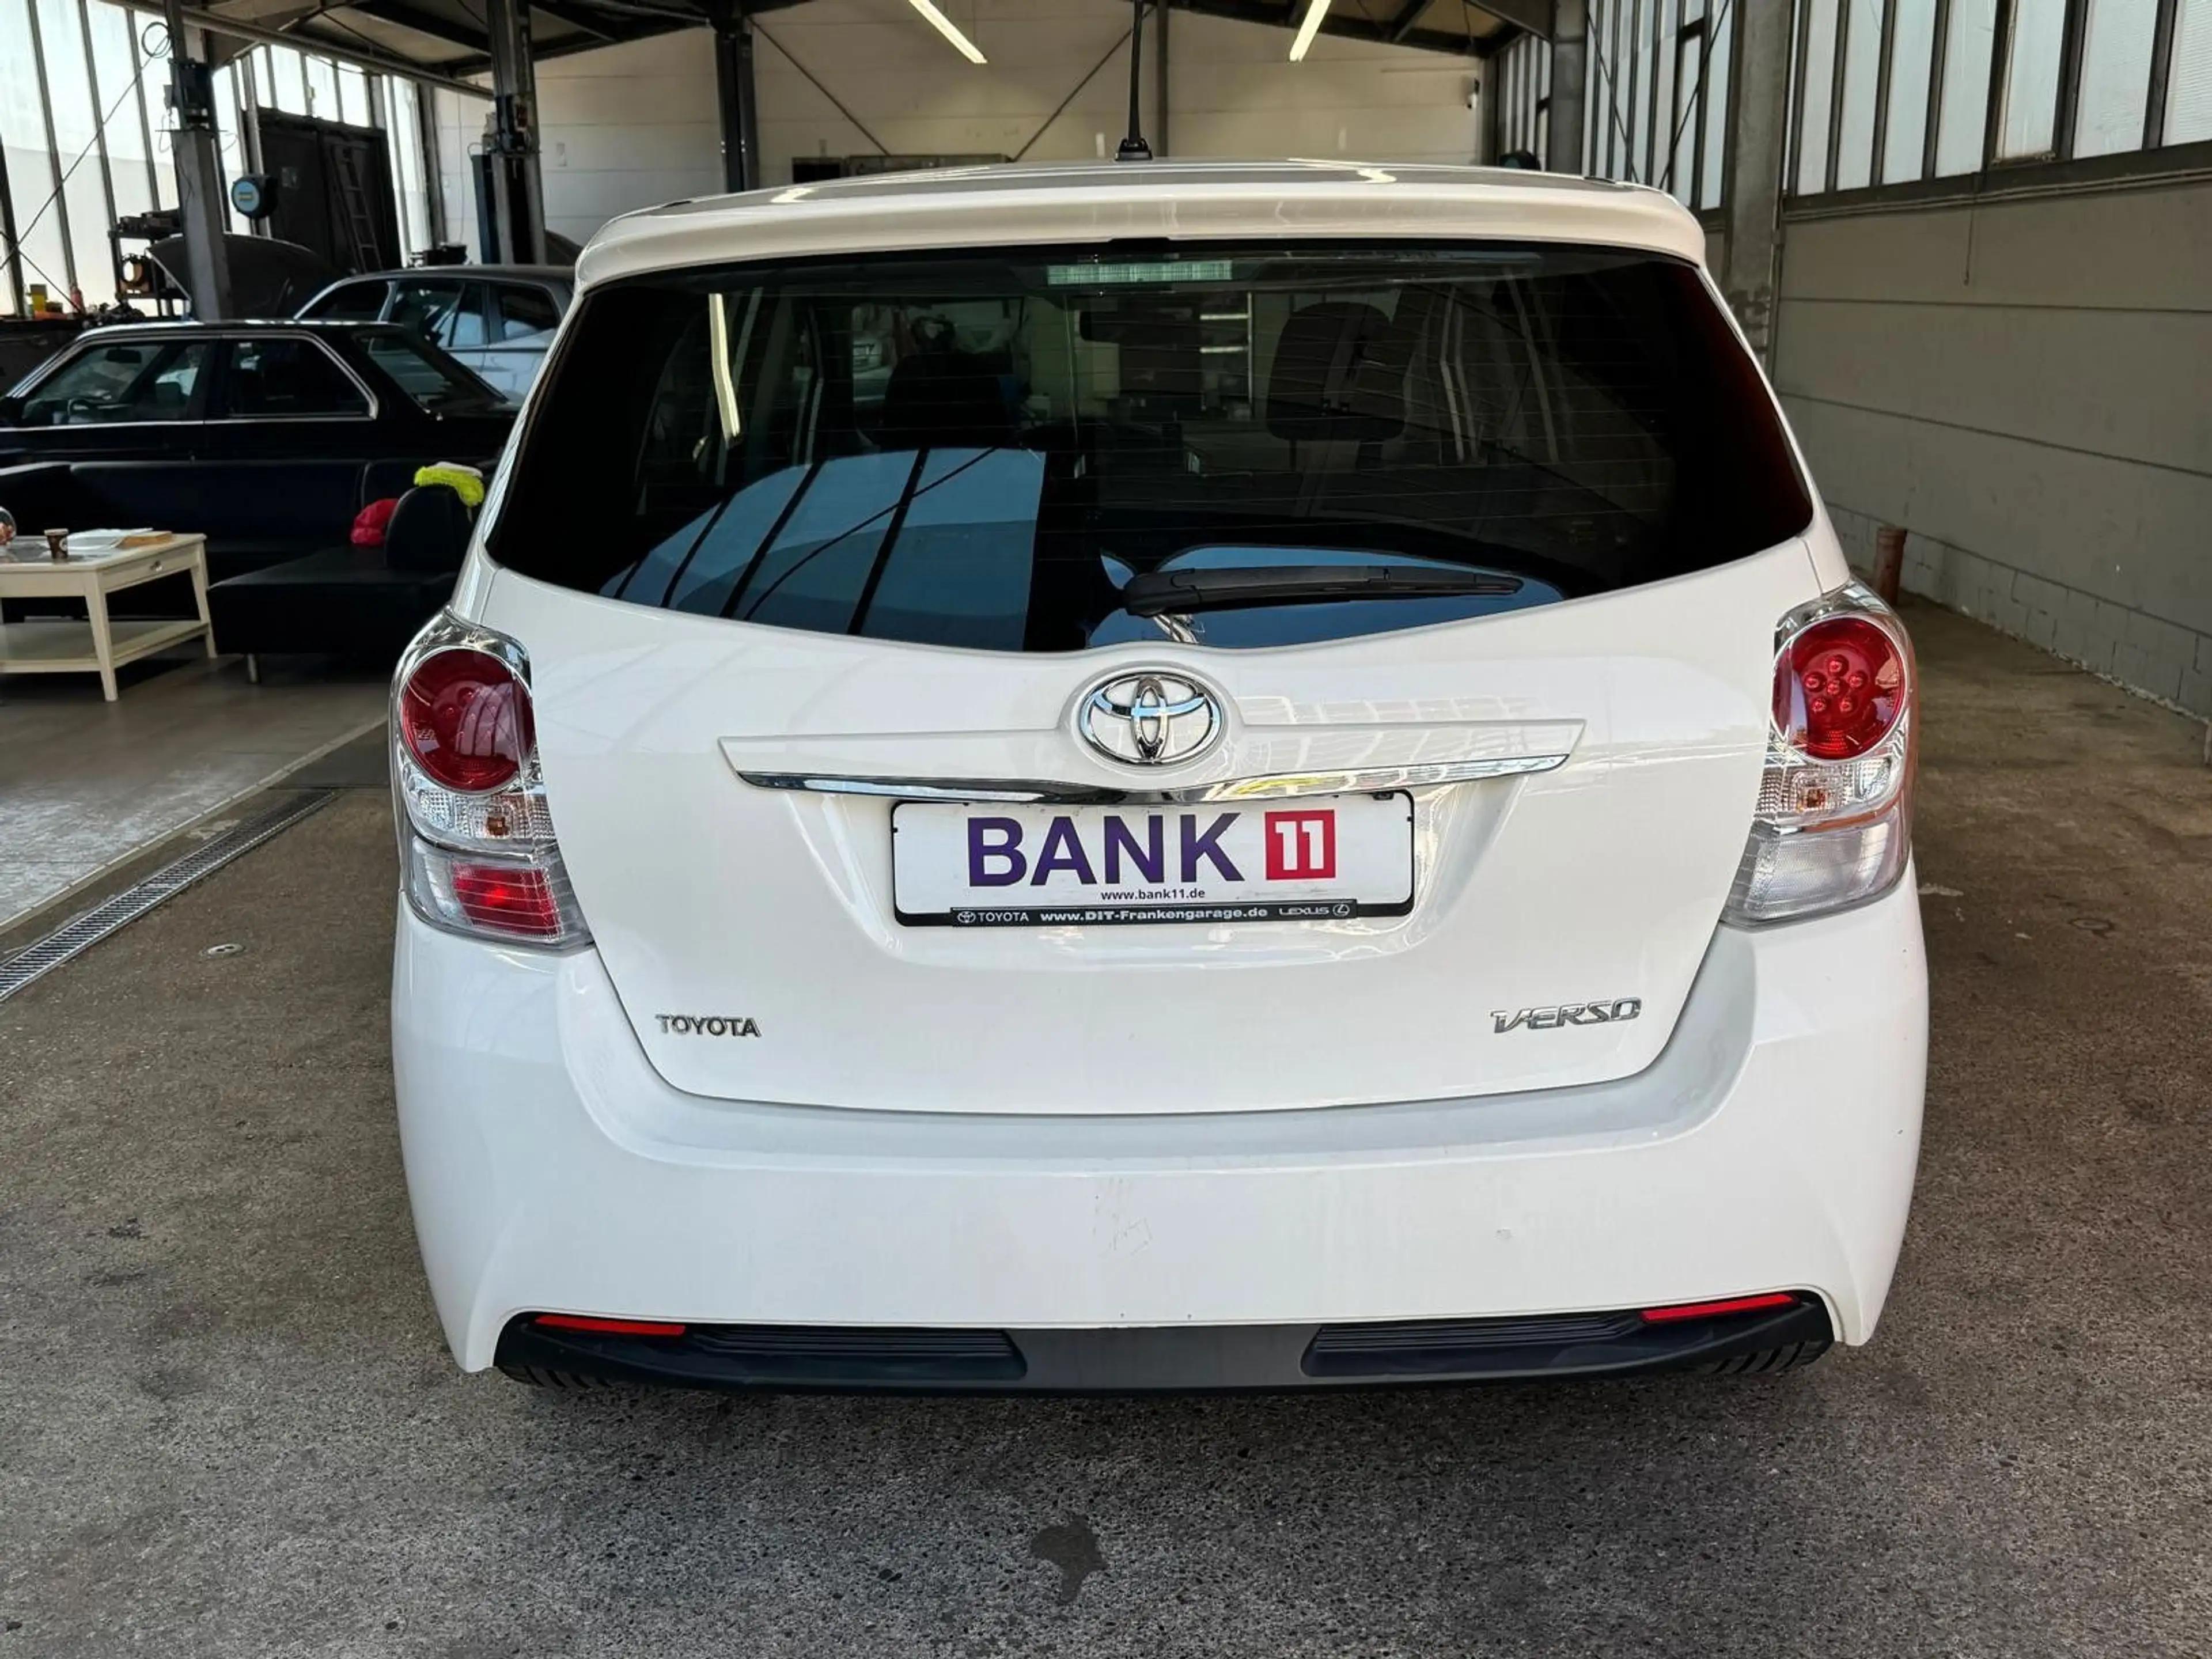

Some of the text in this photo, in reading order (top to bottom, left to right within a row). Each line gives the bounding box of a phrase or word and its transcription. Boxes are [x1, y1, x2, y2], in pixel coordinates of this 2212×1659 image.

[968, 813, 1324, 887] BANK 11
[1101, 888, 1206, 900] www.bank11.de
[978, 906, 1330, 922] TOYOTA www.DIT-Frankengarage.de LEXUS
[654, 1014, 762, 1037] TOYOTA
[1490, 997, 1642, 1033] VERSO
